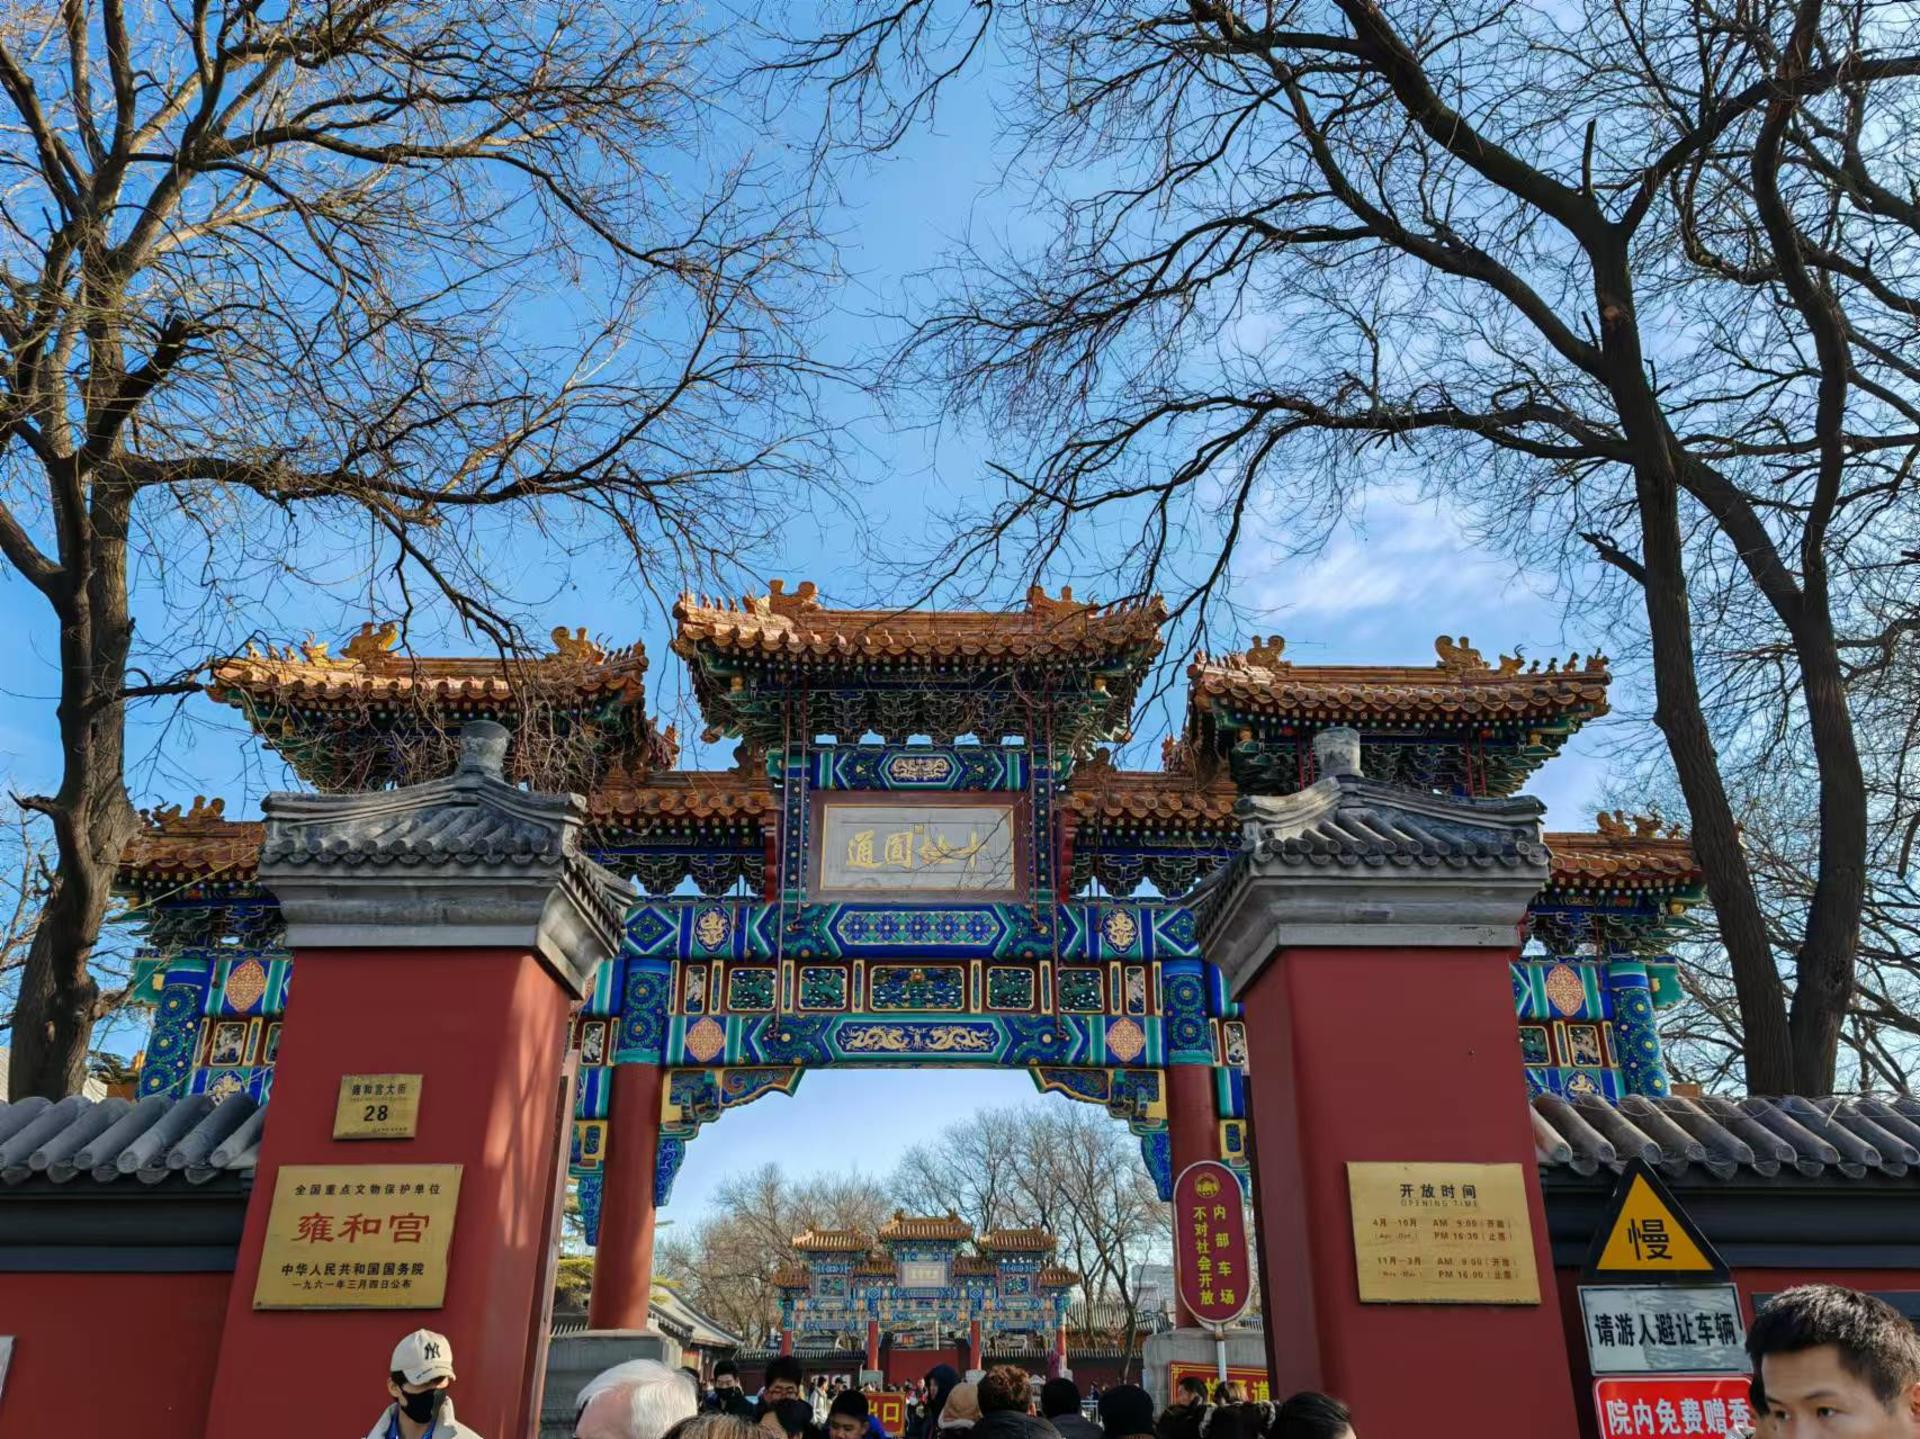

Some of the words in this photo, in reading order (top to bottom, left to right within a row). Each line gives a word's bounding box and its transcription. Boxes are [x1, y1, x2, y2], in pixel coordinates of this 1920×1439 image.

[363, 1104, 389, 1122] 28
[294, 1183, 441, 1196] 全国重点文物保护单位
[1400, 1183, 1477, 1199] 开放时间
[290, 1212, 430, 1244] 雍和宫
[1433, 1219, 1448, 1227] AM
[1434, 1231, 1449, 1240] PM
[1627, 1218, 1673, 1261] 慢
[1193, 1206, 1215, 1305] 不对社会开放
[1213, 1203, 1235, 1305] 内部车场
[281, 1263, 425, 1277] 中华人民共和国国务院
[1438, 1270, 1453, 1279] PM
[292, 1279, 412, 1290] 一九六一年三月四日公布
[1594, 1312, 1737, 1347] 请游人避让车辆
[424, 1342, 441, 1360] NY
[1605, 1398, 1752, 1436] 院内免费赠香
